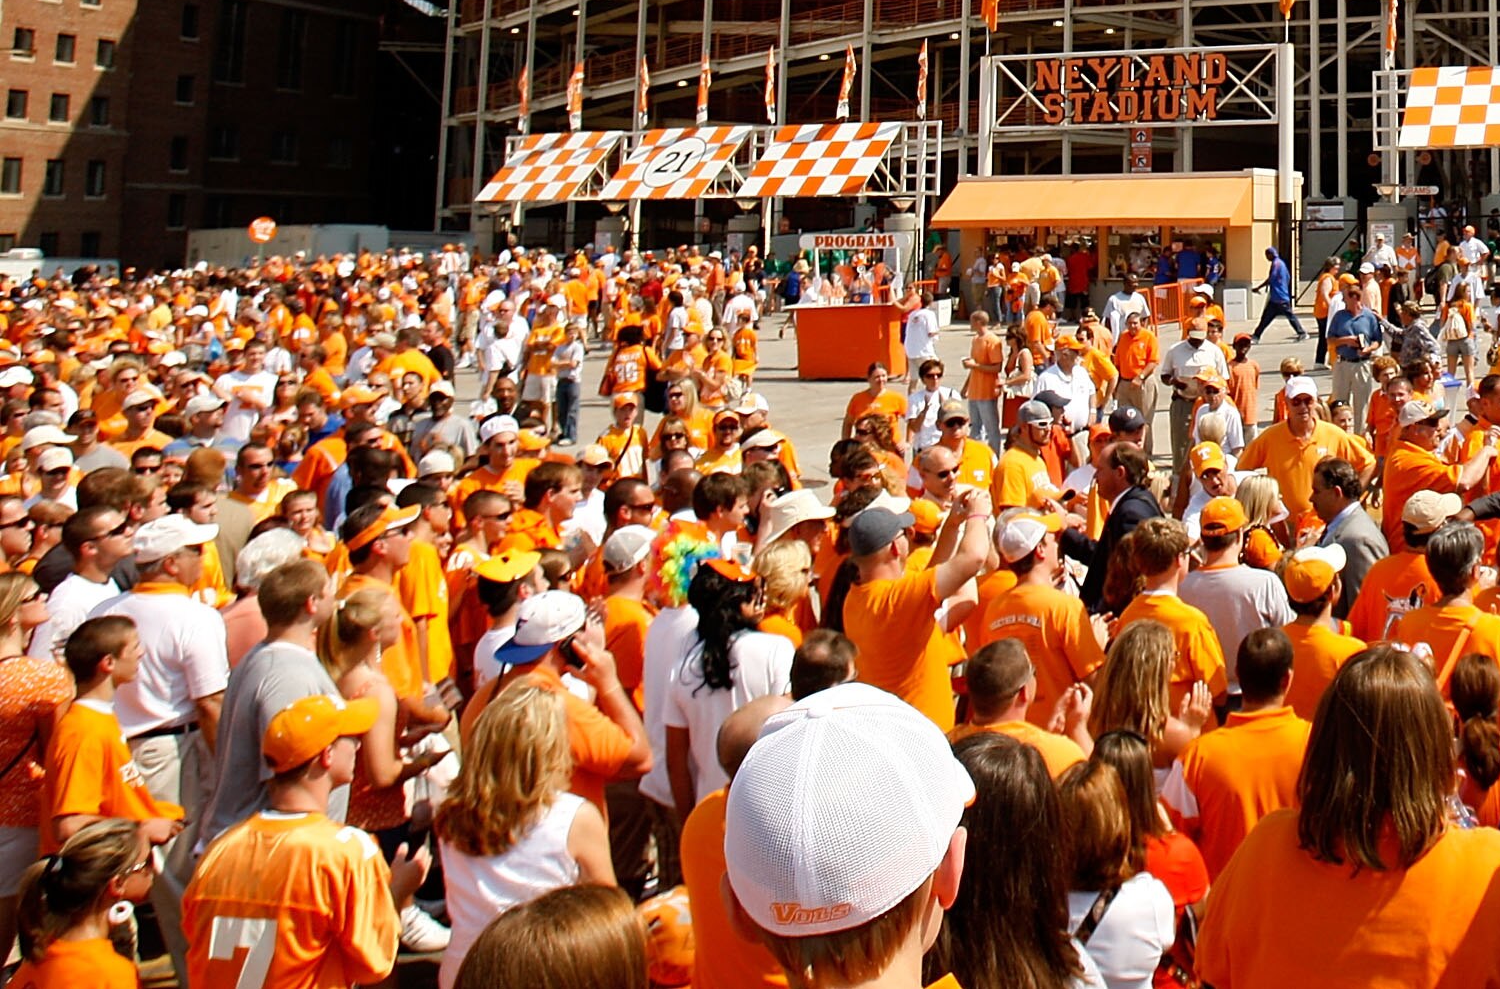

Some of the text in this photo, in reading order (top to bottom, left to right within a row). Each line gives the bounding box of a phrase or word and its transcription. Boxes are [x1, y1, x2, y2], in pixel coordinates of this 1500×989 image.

[1035, 52, 1228, 91] NEYLAND
[1043, 87, 1217, 124] STADIUM
[653, 151, 694, 173] 21
[814, 234, 895, 248] PROGRAMS
[208, 916, 278, 989] 7
